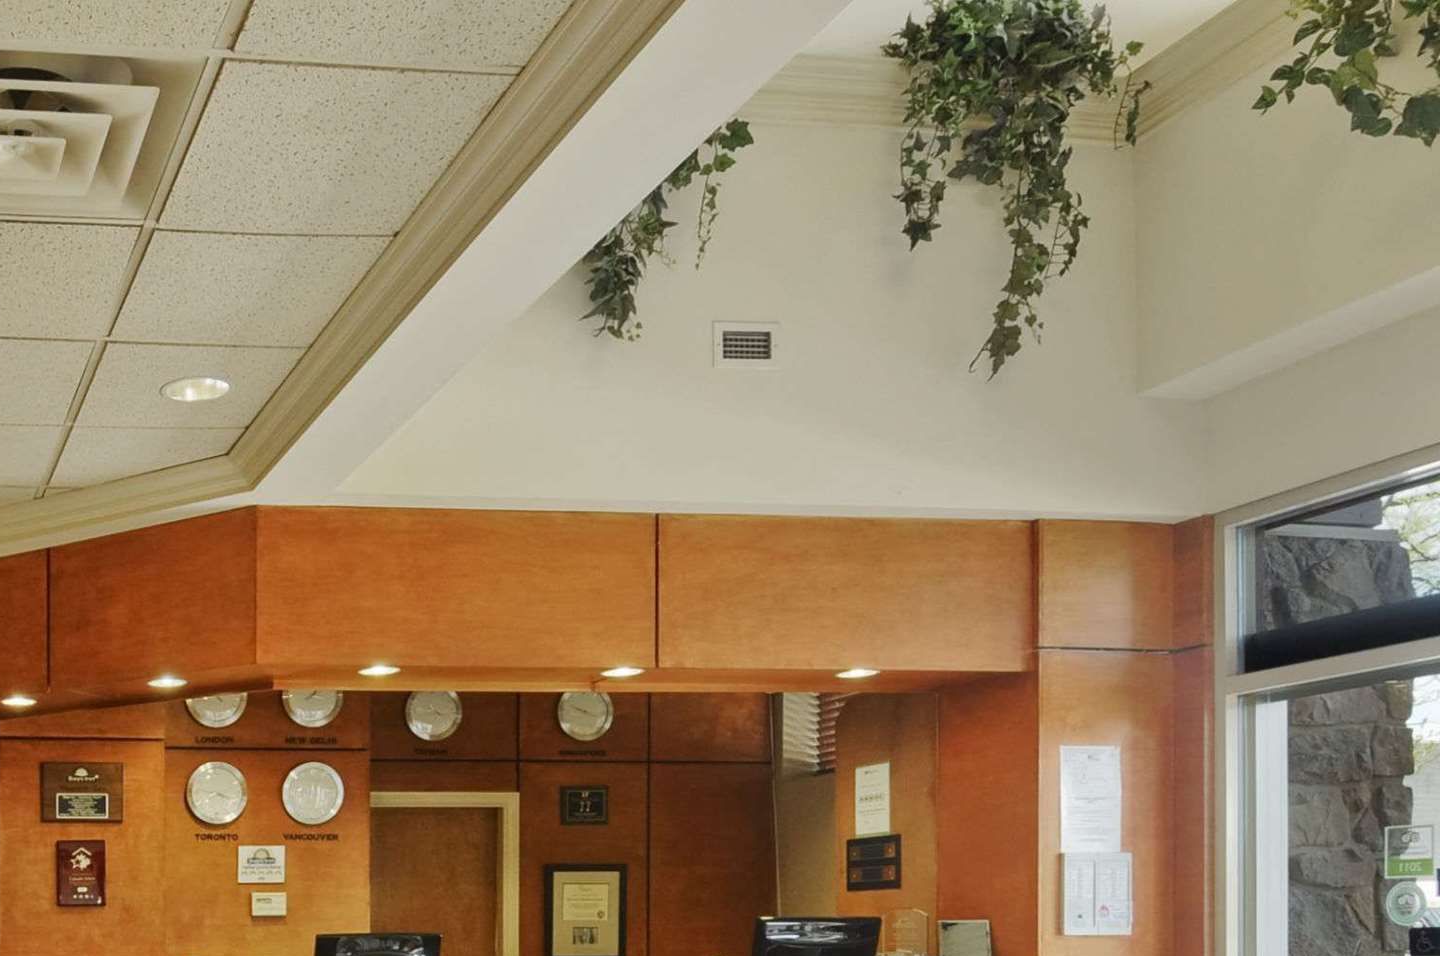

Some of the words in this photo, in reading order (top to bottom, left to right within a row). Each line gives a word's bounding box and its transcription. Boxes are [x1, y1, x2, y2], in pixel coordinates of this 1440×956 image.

[195, 736, 235, 744] LONDON
[195, 833, 239, 842] TORONTO
[283, 833, 338, 842] VANCOUVER
